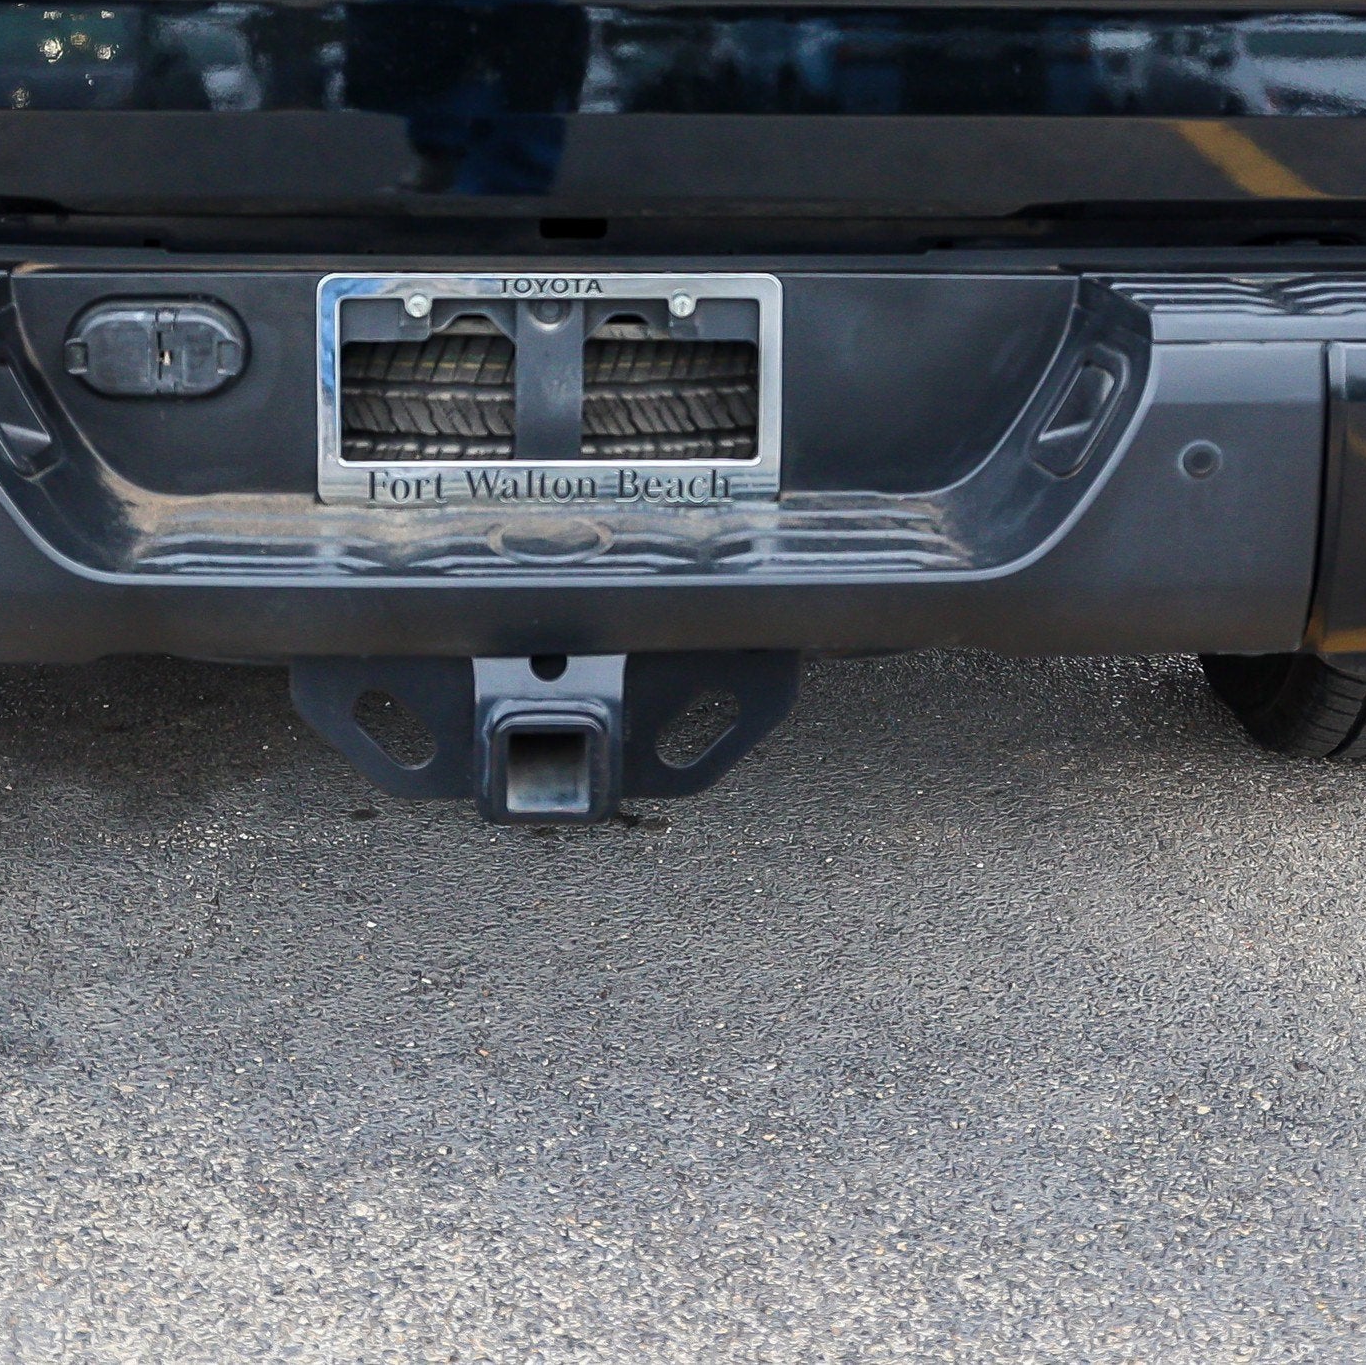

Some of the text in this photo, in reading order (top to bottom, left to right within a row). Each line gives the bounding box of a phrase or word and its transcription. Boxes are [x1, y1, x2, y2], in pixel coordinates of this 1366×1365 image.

[499, 277, 603, 297] TOYOTA
[366, 468, 735, 505] Fort Walton Beach
